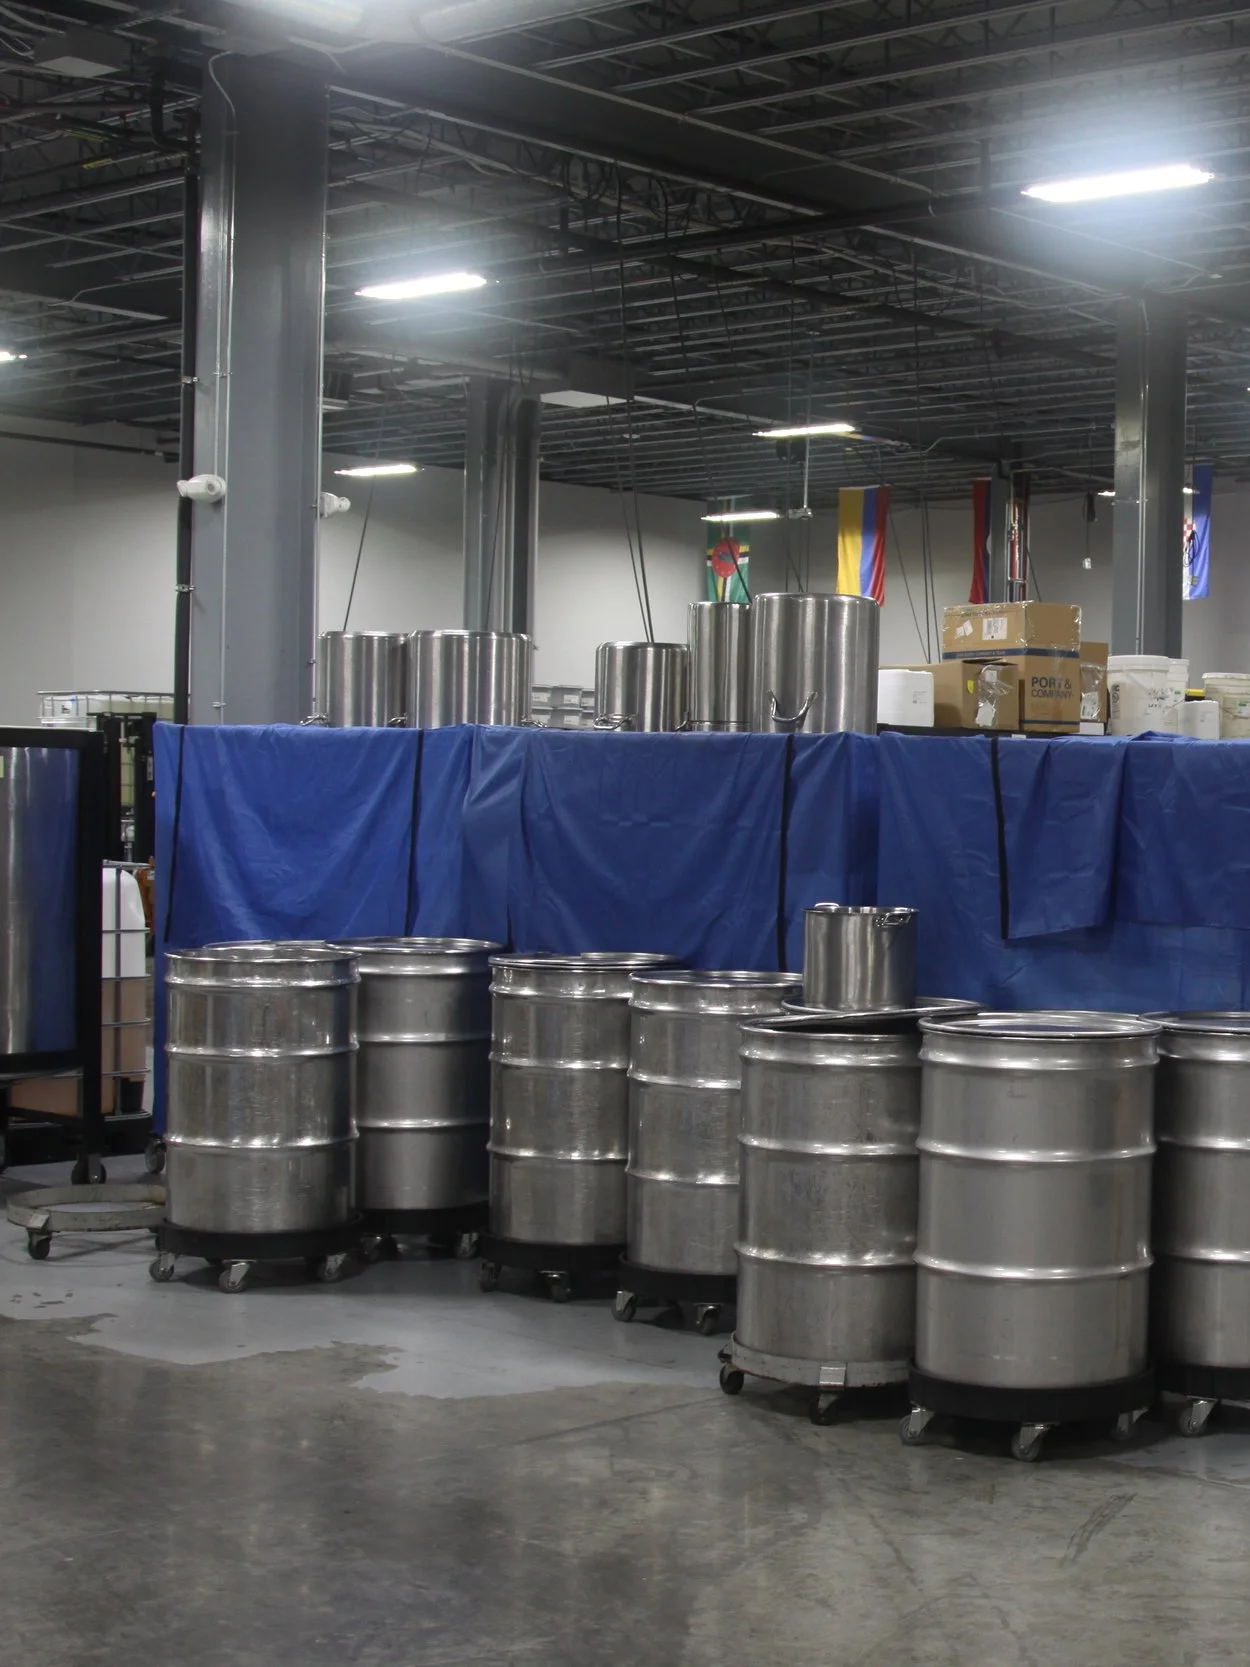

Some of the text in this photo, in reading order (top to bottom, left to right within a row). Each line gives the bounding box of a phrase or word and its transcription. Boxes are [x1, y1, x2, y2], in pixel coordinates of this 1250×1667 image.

[1031, 676, 1072, 690] PORT &
[1031, 689, 1073, 699] COMPANY
